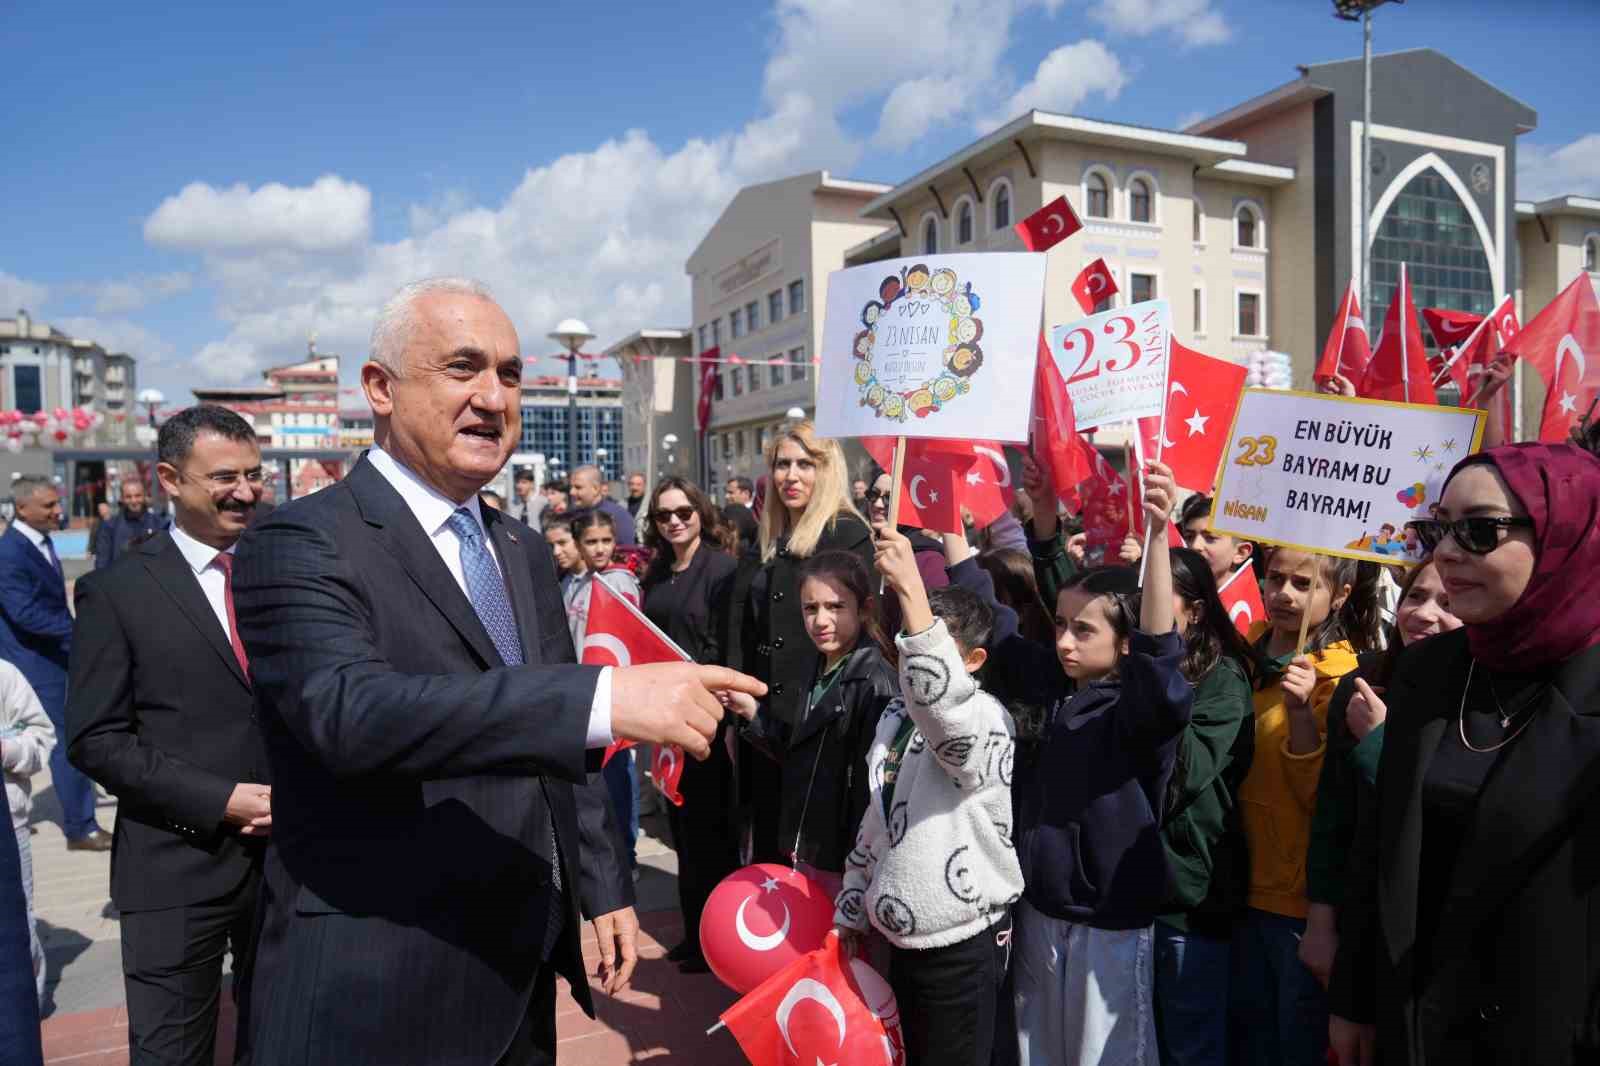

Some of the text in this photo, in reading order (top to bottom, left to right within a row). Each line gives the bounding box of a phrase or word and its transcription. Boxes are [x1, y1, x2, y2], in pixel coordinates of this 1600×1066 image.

[885, 325, 897, 347] 23
[1063, 316, 1142, 384] 23
[1235, 434, 1277, 467] 23
[1294, 420, 1393, 450] EN BÜYÜK
[1282, 453, 1391, 486] BAYRAM BU
[1223, 499, 1268, 522] NİSAN
[1286, 489, 1371, 524] BAYRAM!
